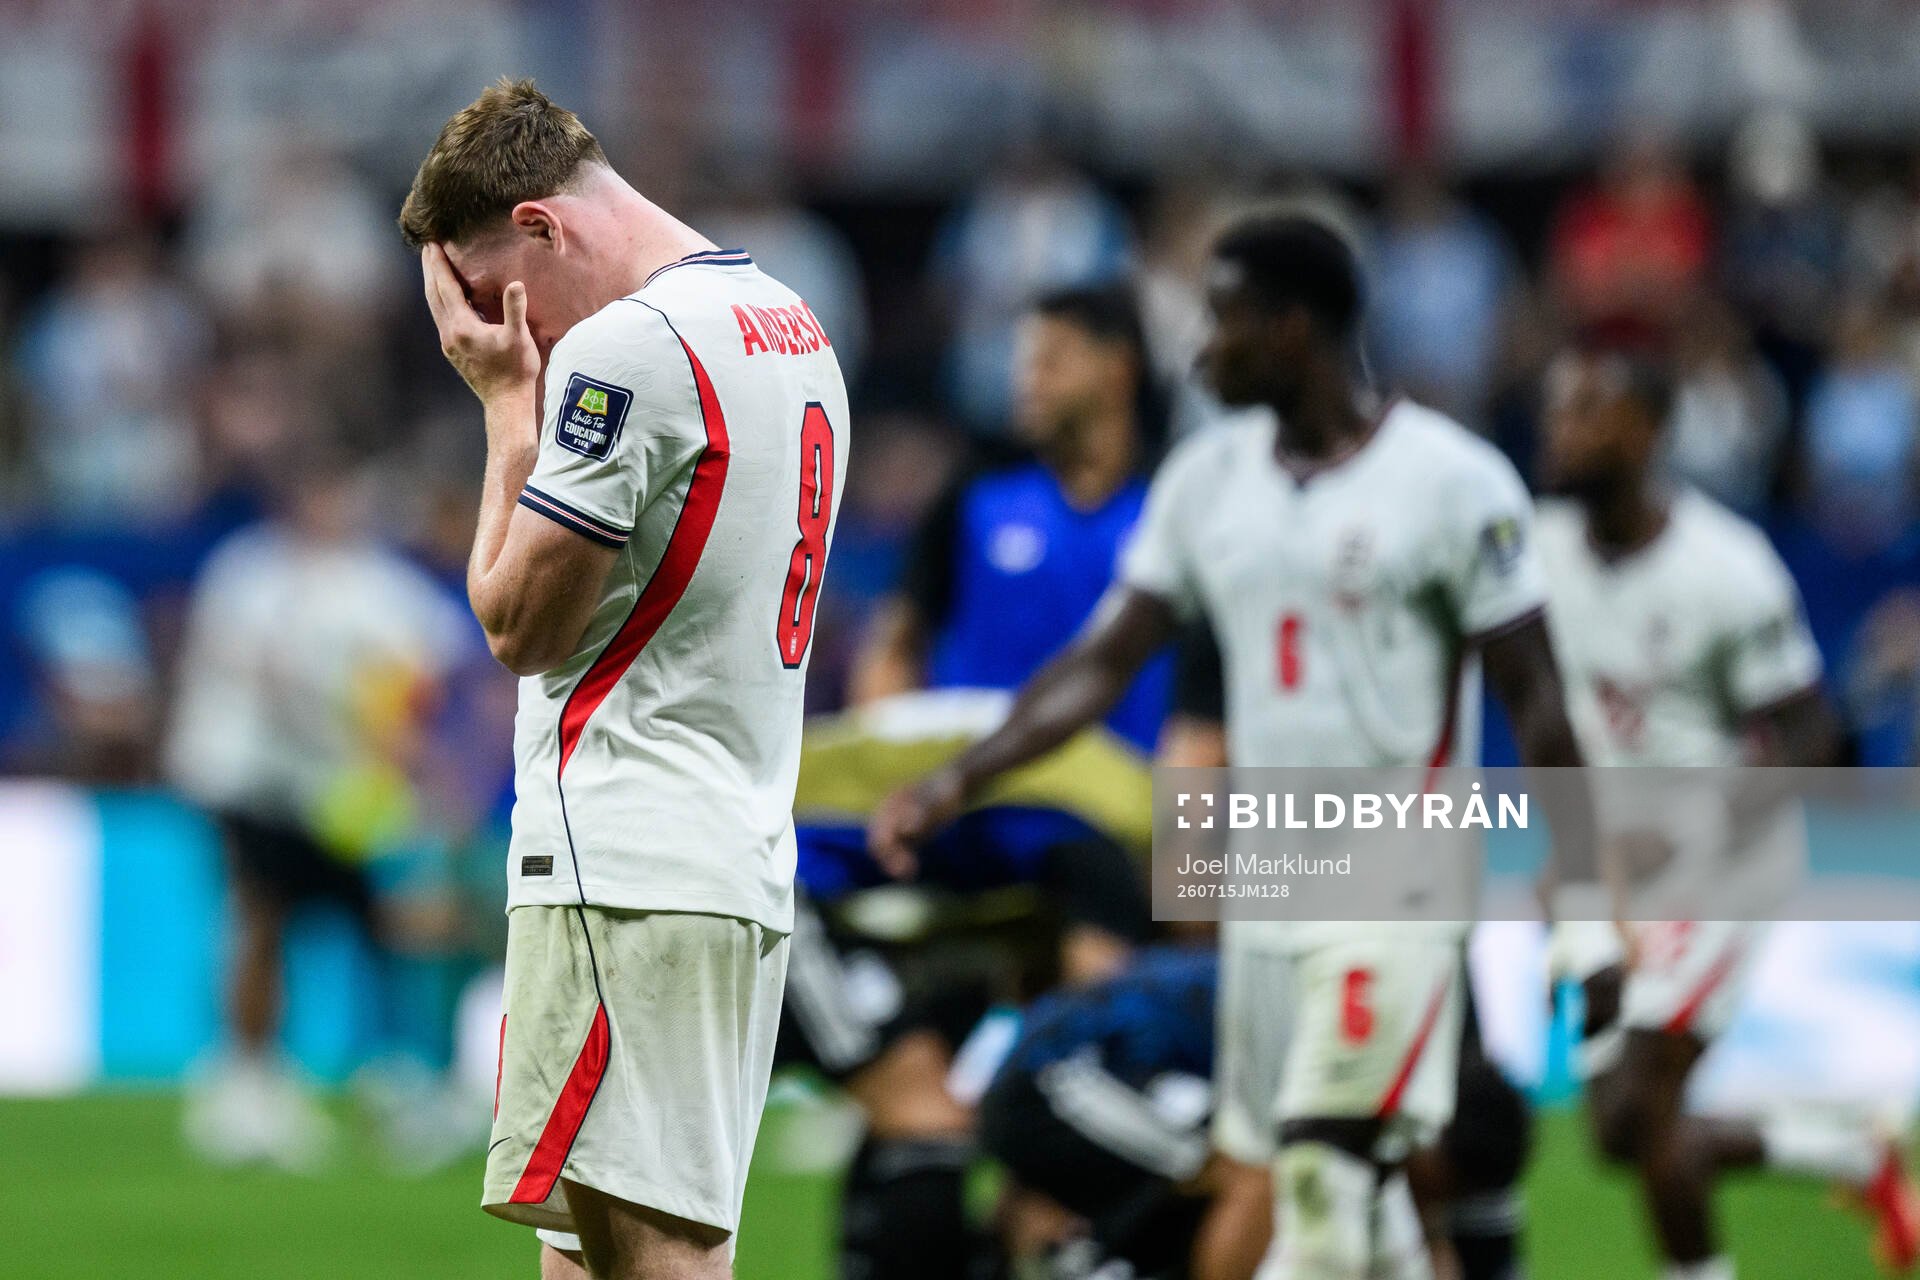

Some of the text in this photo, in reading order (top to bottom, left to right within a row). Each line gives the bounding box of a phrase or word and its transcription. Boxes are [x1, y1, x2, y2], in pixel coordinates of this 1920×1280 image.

[571, 409, 606, 429] Unite For
[564, 421, 607, 445] EDUCATION
[573, 438, 589, 448] FIFA
[776, 401, 834, 669] 8
[1340, 966, 1375, 1043] 6
